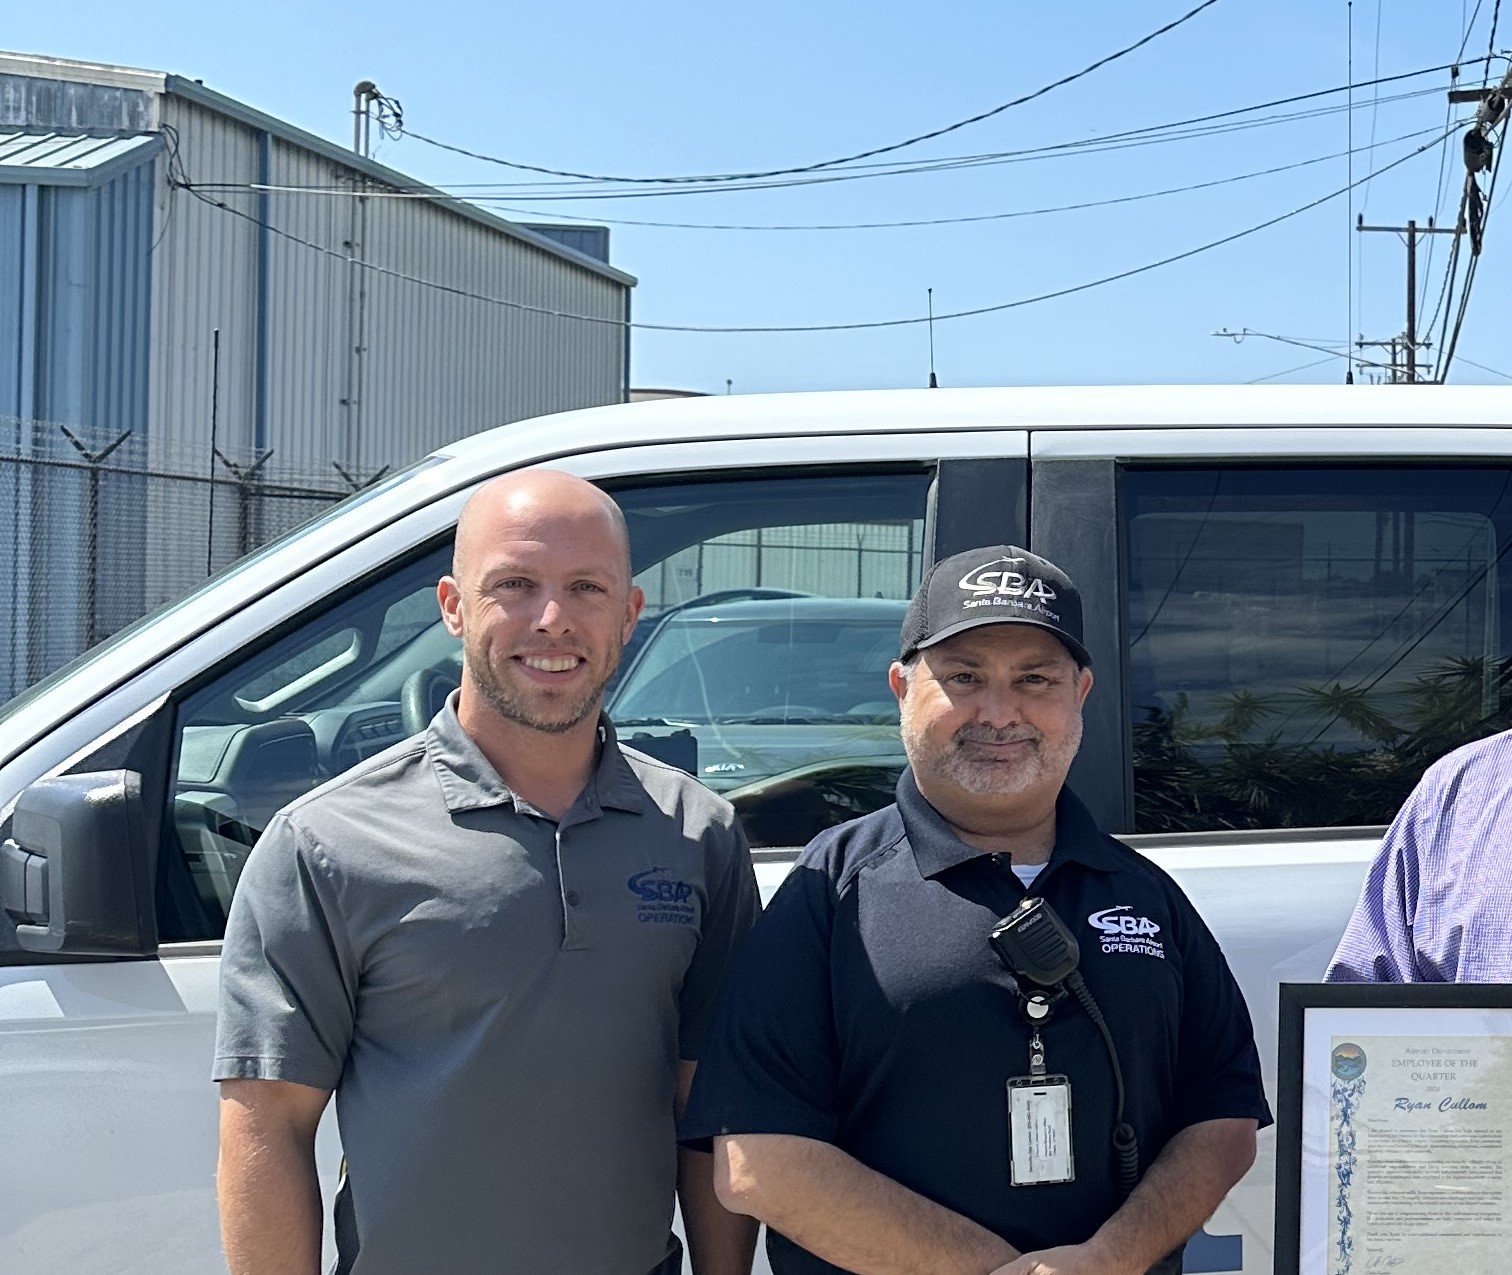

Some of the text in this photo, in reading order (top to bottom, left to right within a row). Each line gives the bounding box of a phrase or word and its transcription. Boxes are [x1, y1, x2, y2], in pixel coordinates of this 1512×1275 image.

[970, 571, 1057, 604] SBA
[962, 598, 991, 610] Santa
[640, 879, 693, 904] SBA
[1101, 916, 1161, 938] SBA
[1101, 943, 1165, 960] OPERATIONS
[1391, 1059, 1479, 1068] EMPLOYEE OF THE
[1410, 1072, 1457, 1081] QUARTER
[1393, 1096, 1488, 1113] Ryan Cullom
